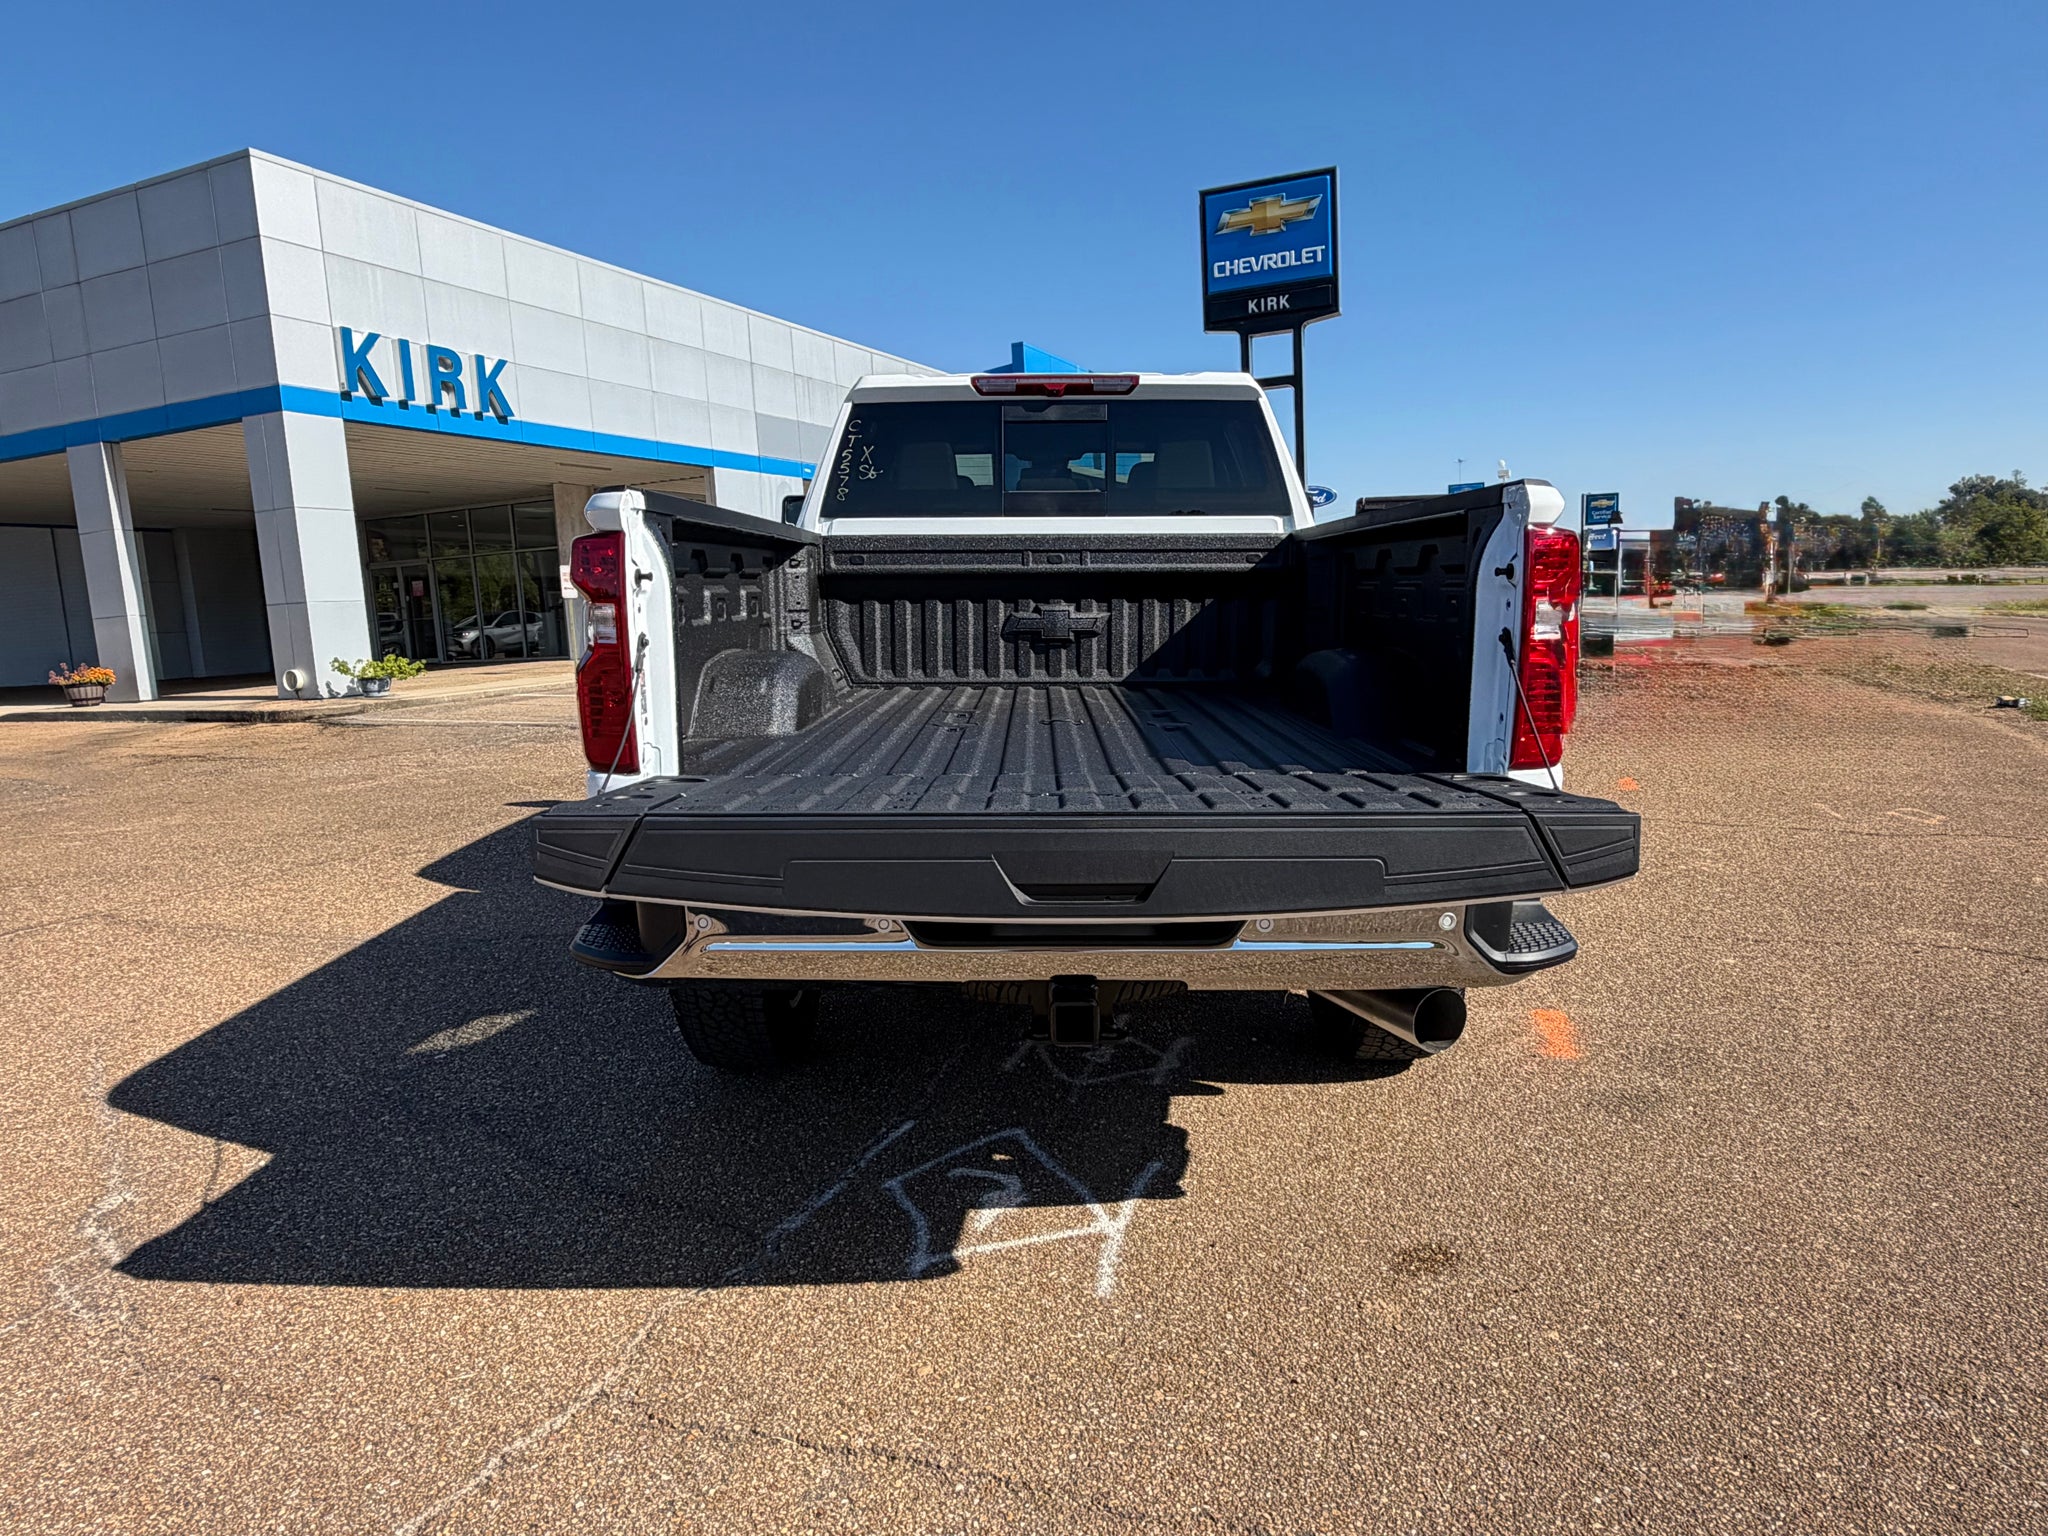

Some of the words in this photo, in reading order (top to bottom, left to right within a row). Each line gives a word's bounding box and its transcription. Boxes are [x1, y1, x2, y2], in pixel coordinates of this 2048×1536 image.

[1213, 245, 1326, 278] CHEVROLET
[1248, 294, 1290, 314] KIRK
[333, 326, 515, 417] KIRK
